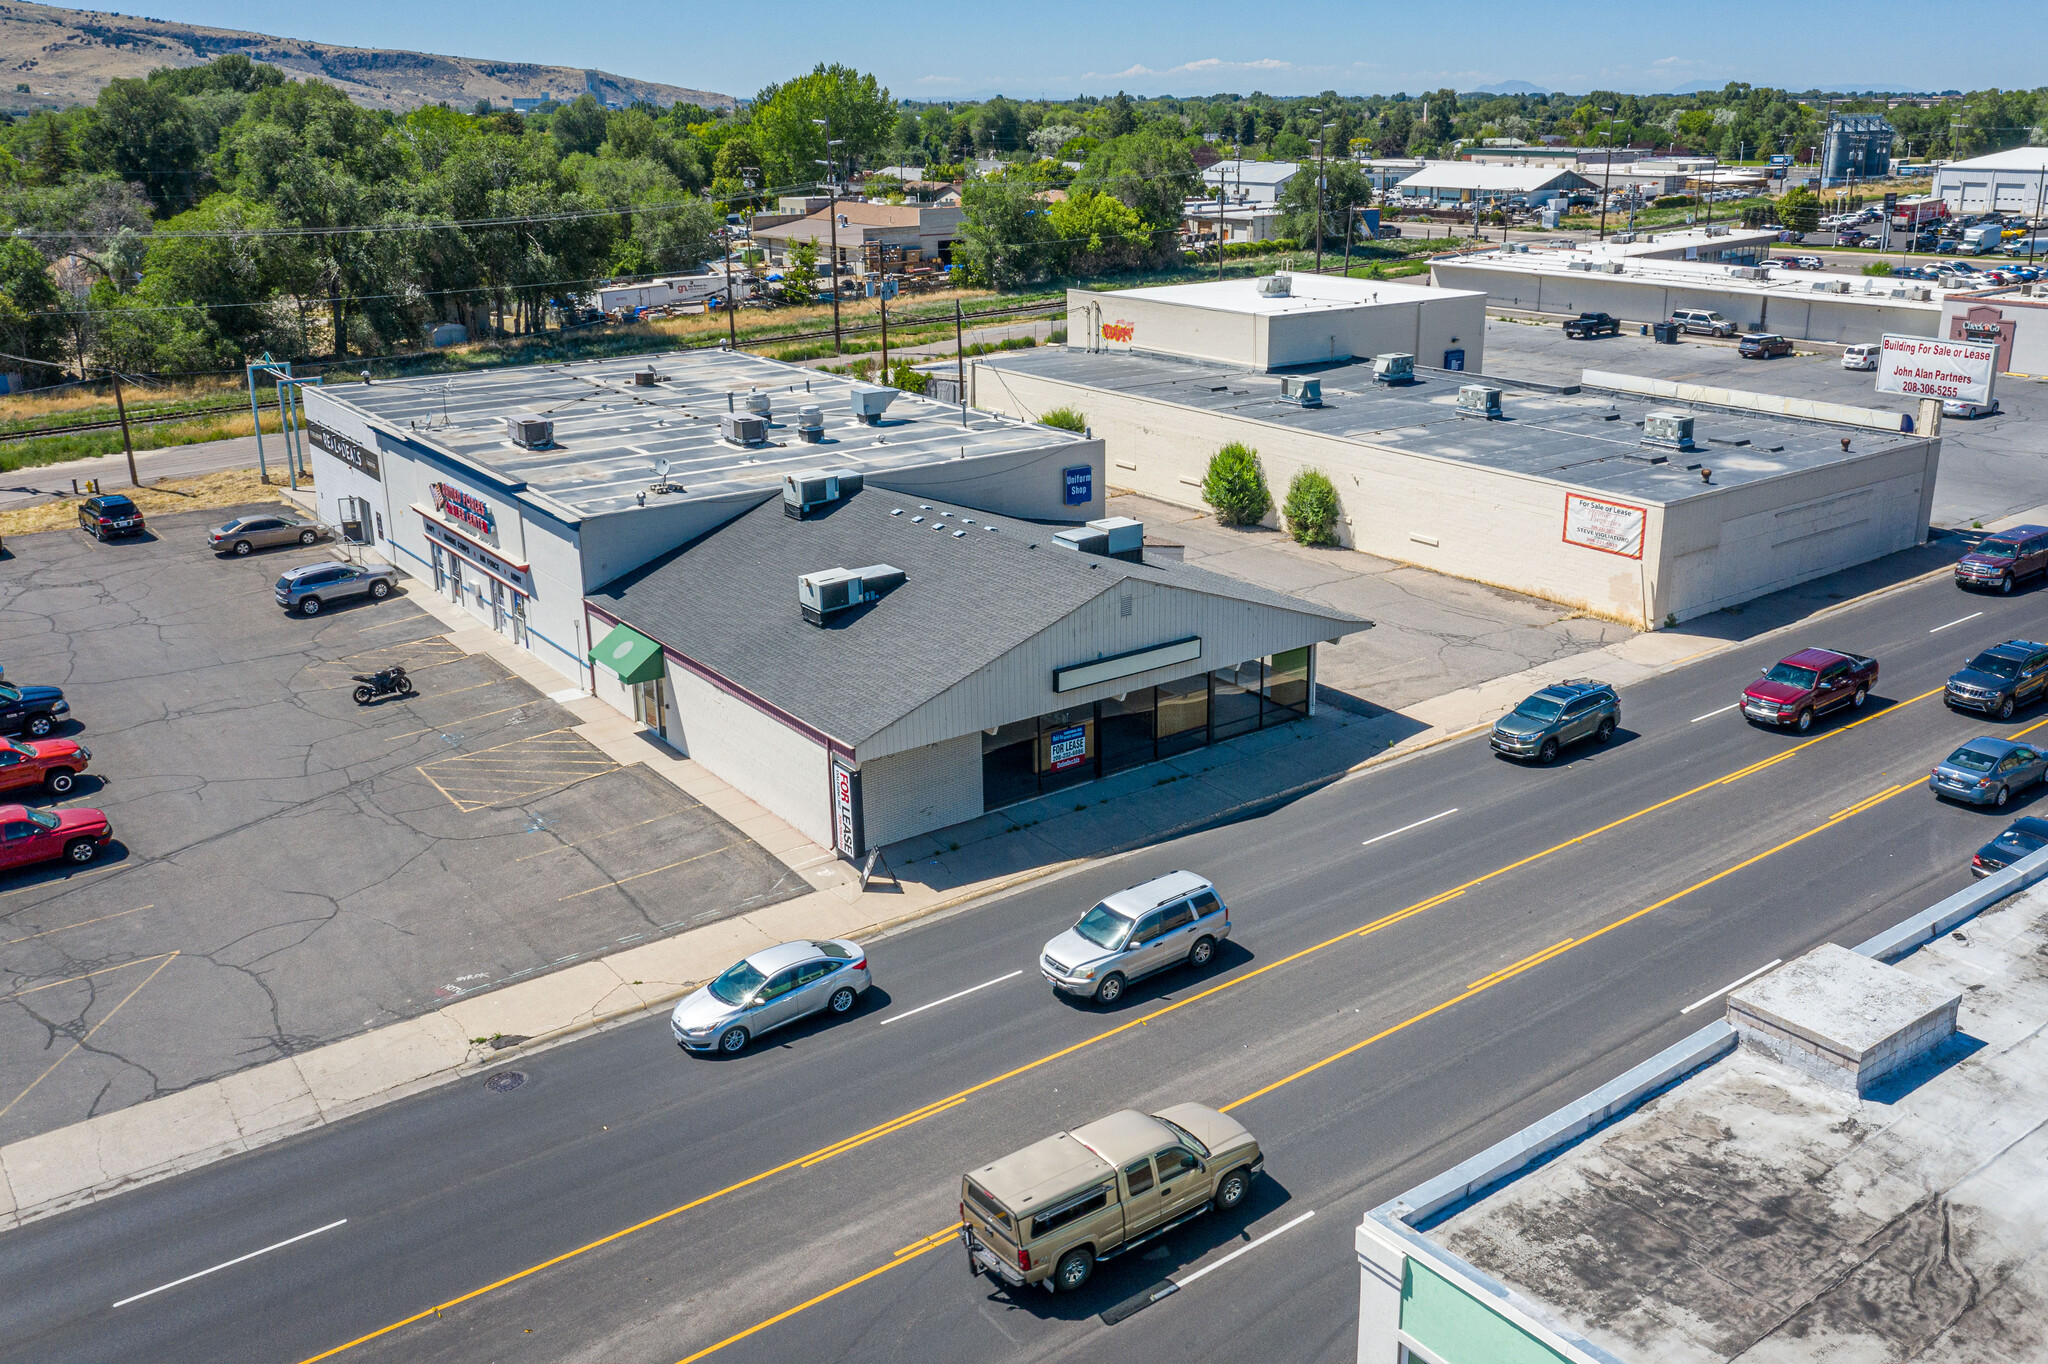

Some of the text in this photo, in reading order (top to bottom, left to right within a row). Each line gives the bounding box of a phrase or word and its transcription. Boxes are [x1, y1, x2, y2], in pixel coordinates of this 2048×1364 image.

[1962, 321, 1984, 332] Check
[1990, 324, 2000, 332] Go
[1884, 340, 1990, 360] Building For Sale or Lease
[1894, 366, 1972, 384] John Alan Partners
[1902, 381, 1958, 398] 208-306-5255
[1066, 474, 1091, 484] Uniform
[1072, 486, 1086, 494] Shop
[463, 493, 487, 516] FORCES
[1591, 502, 1604, 510] Sale
[1614, 507, 1632, 516] Lease
[1576, 527, 1594, 535] STEVE
[486, 558, 500, 572] FORCE
[1052, 738, 1084, 756] FOR LEASE
[840, 772, 850, 804] FOR
[842, 806, 852, 855] LEASE
